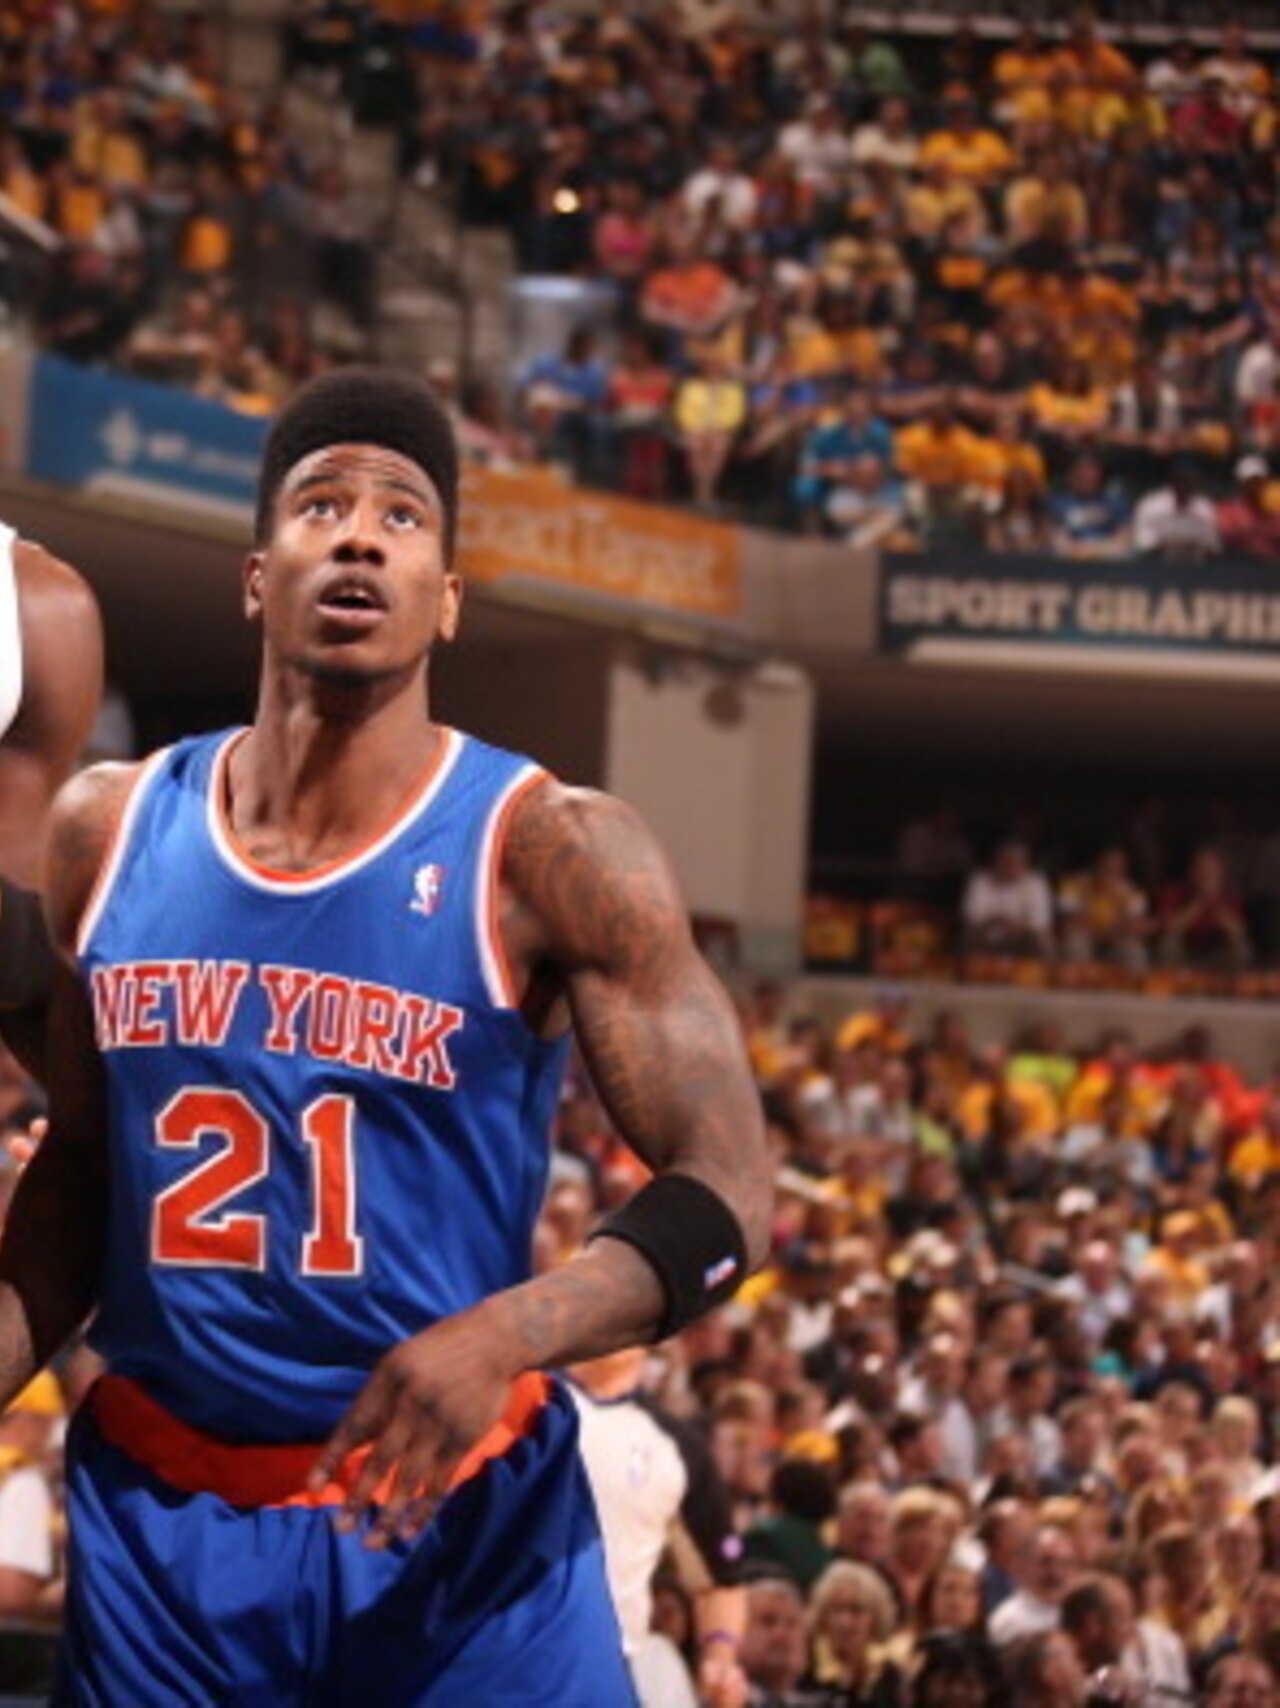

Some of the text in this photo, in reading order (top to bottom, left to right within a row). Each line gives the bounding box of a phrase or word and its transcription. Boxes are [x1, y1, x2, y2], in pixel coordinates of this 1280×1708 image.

[888, 575, 1070, 631] SPORT
[90, 959, 464, 1090] NEW YORK
[151, 1085, 364, 1277] 21
